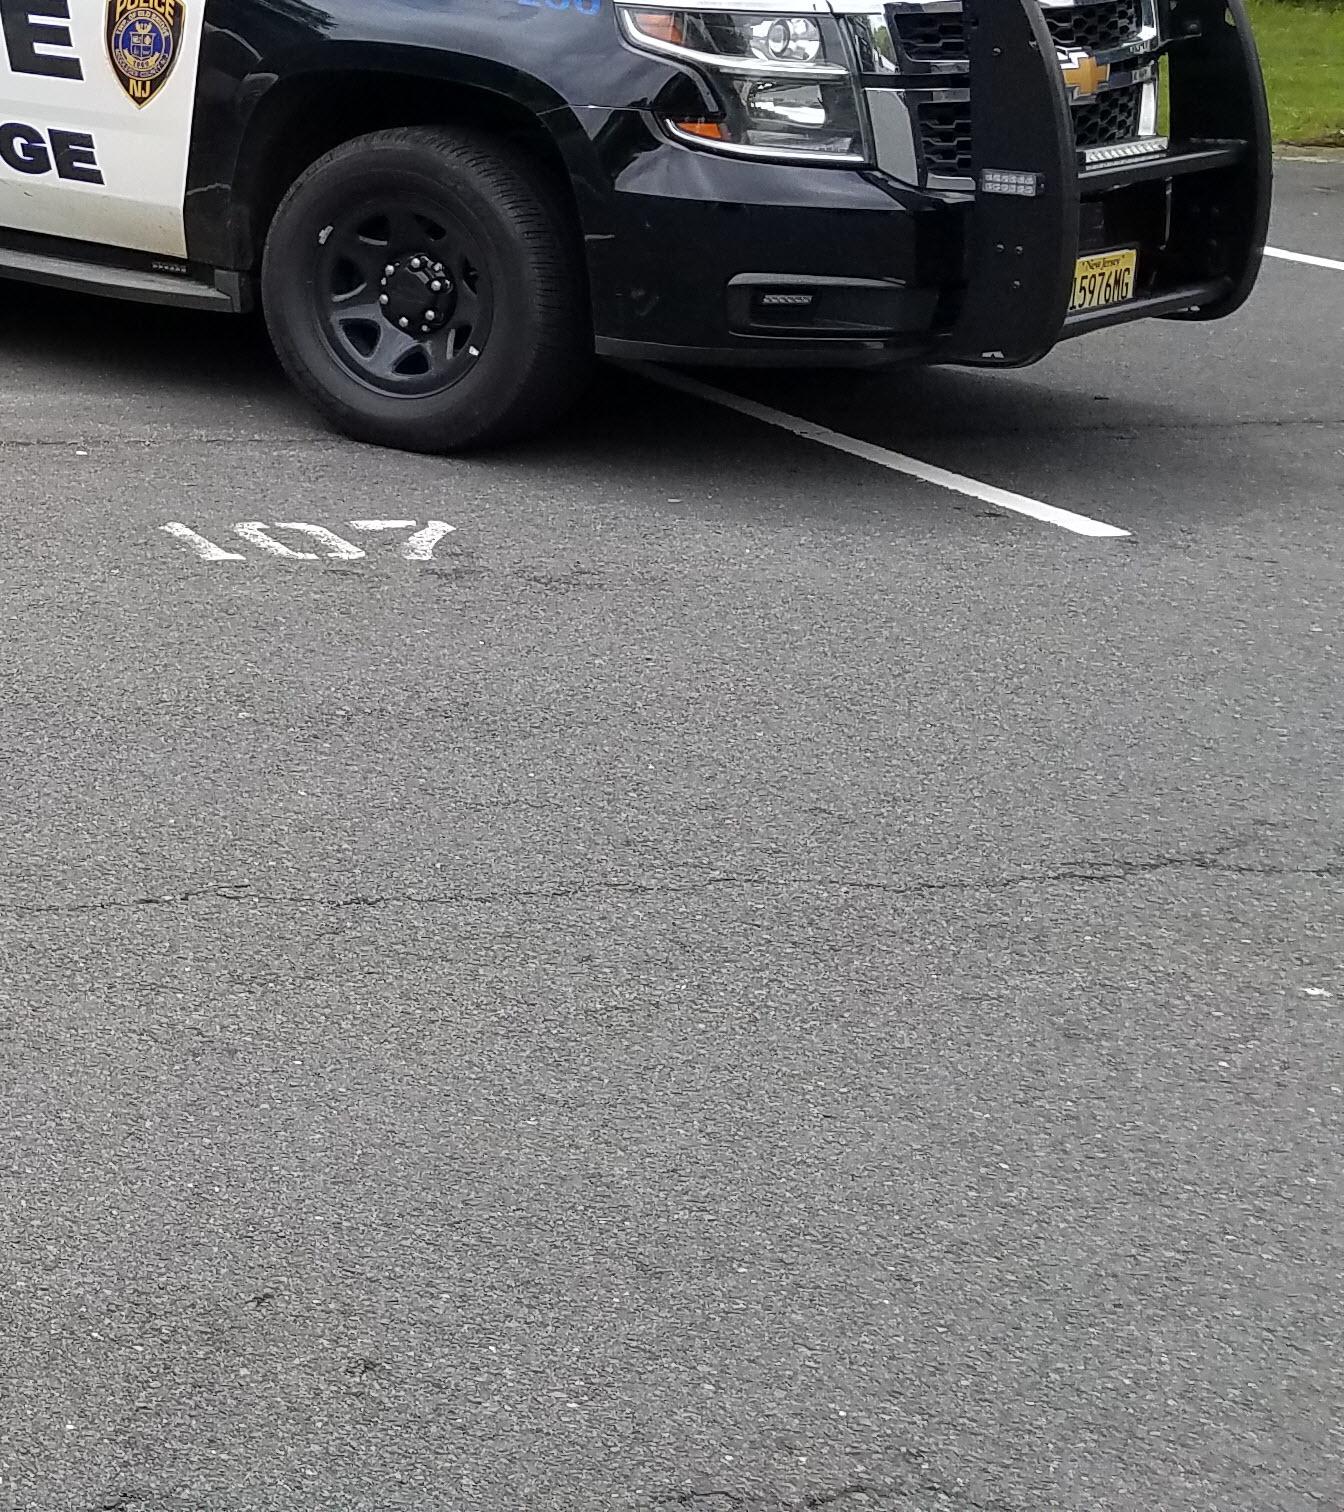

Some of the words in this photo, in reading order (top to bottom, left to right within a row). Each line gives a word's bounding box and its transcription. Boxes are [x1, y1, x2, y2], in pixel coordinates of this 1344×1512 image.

[129, 78, 151, 98] NJ
[1085, 259, 1101, 270] New
[1069, 267, 1131, 310] 15976MG
[158, 519, 457, 561] 107
